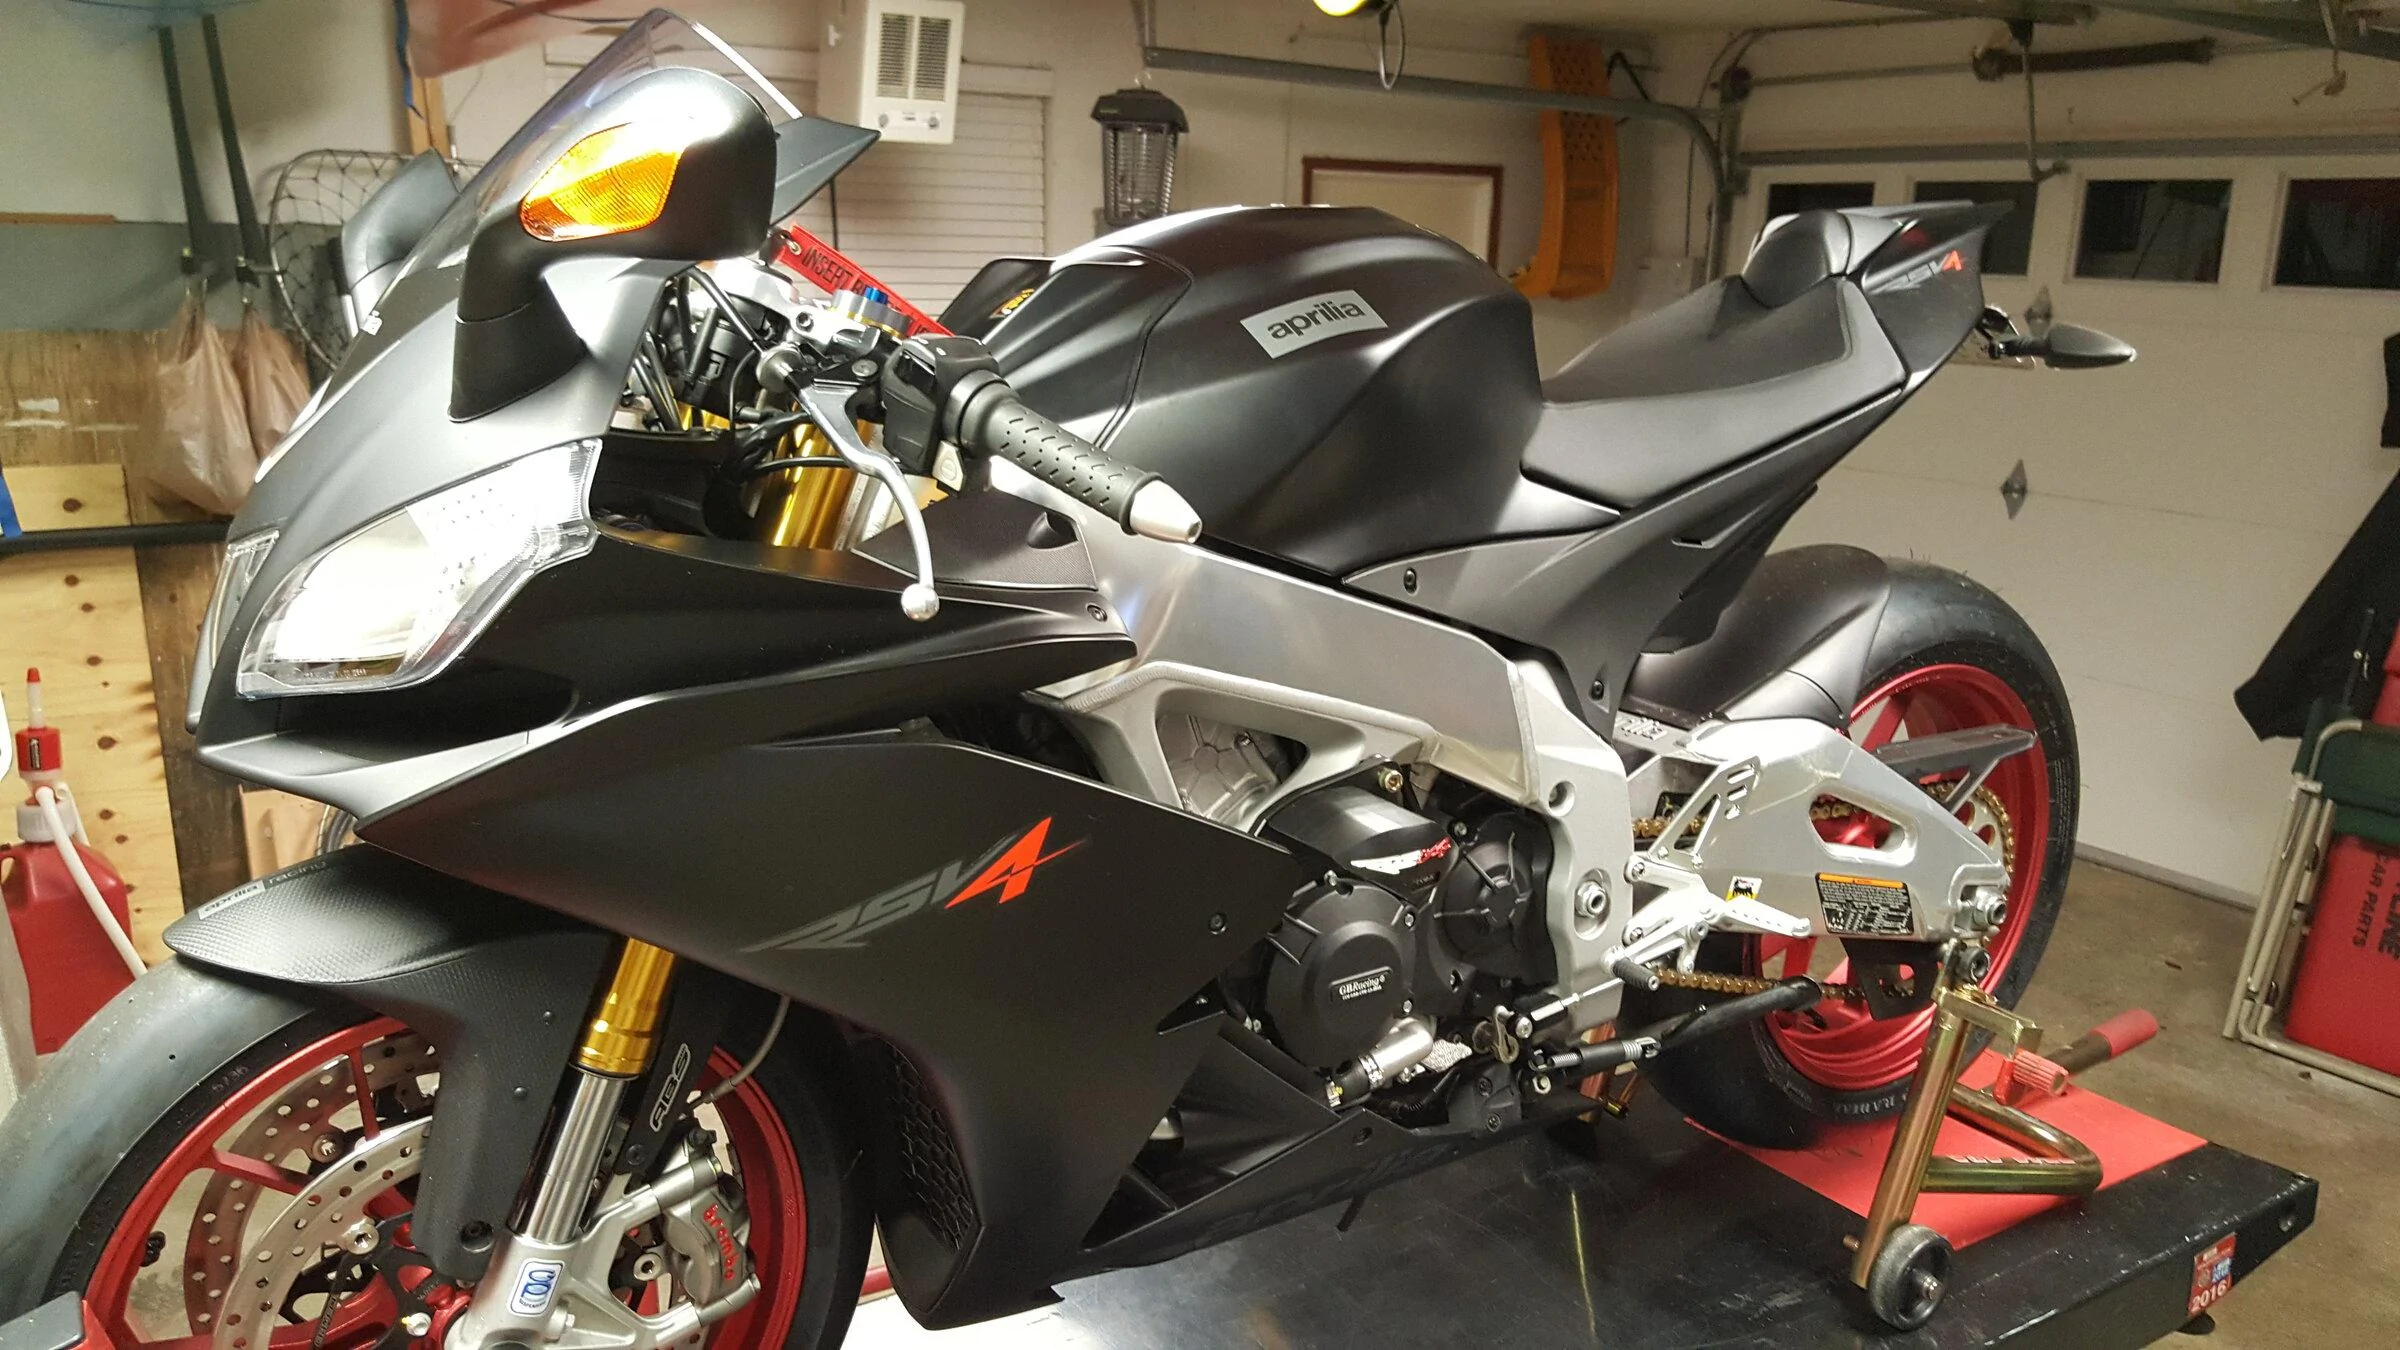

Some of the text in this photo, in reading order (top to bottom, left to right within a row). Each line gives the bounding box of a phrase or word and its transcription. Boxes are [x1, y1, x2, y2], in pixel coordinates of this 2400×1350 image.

[802, 247, 854, 290] INSERT
[1267, 300, 1366, 340] aprilia
[204, 884, 259, 913] aprilia
[2352, 890, 2377, 947] PARTS
[650, 1043, 691, 1132] ABS
[703, 1202, 741, 1281] brembo
[2191, 1279, 2228, 1312] 2016
